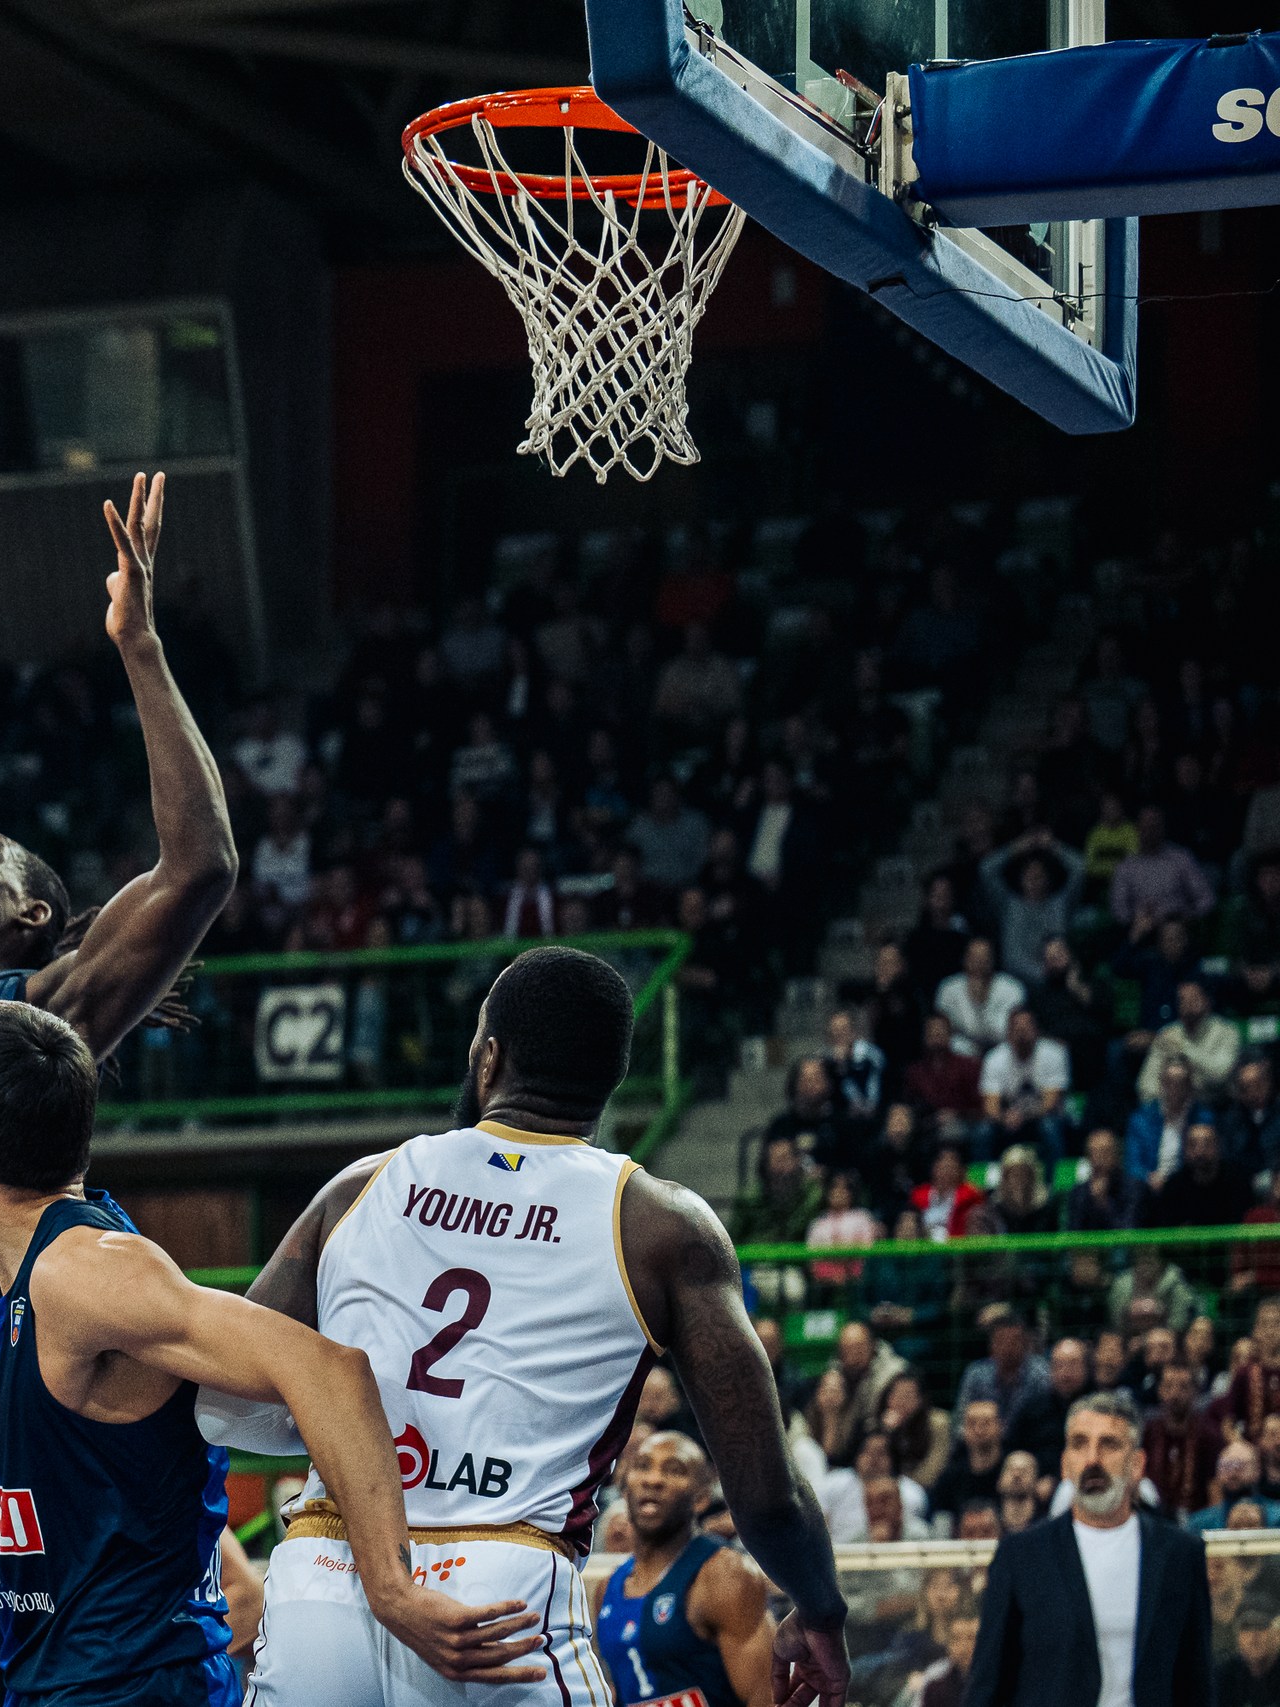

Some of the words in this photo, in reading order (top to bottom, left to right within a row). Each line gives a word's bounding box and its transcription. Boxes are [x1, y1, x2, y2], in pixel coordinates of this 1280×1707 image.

[1212, 87, 1280, 143] S
[267, 1000, 340, 1066] C2
[403, 1183, 514, 1238] YOUNG
[515, 1204, 562, 1244] JR.
[405, 1267, 492, 1400] 2
[314, 1554, 346, 1572] Moja
[627, 1646, 654, 1698] 1
